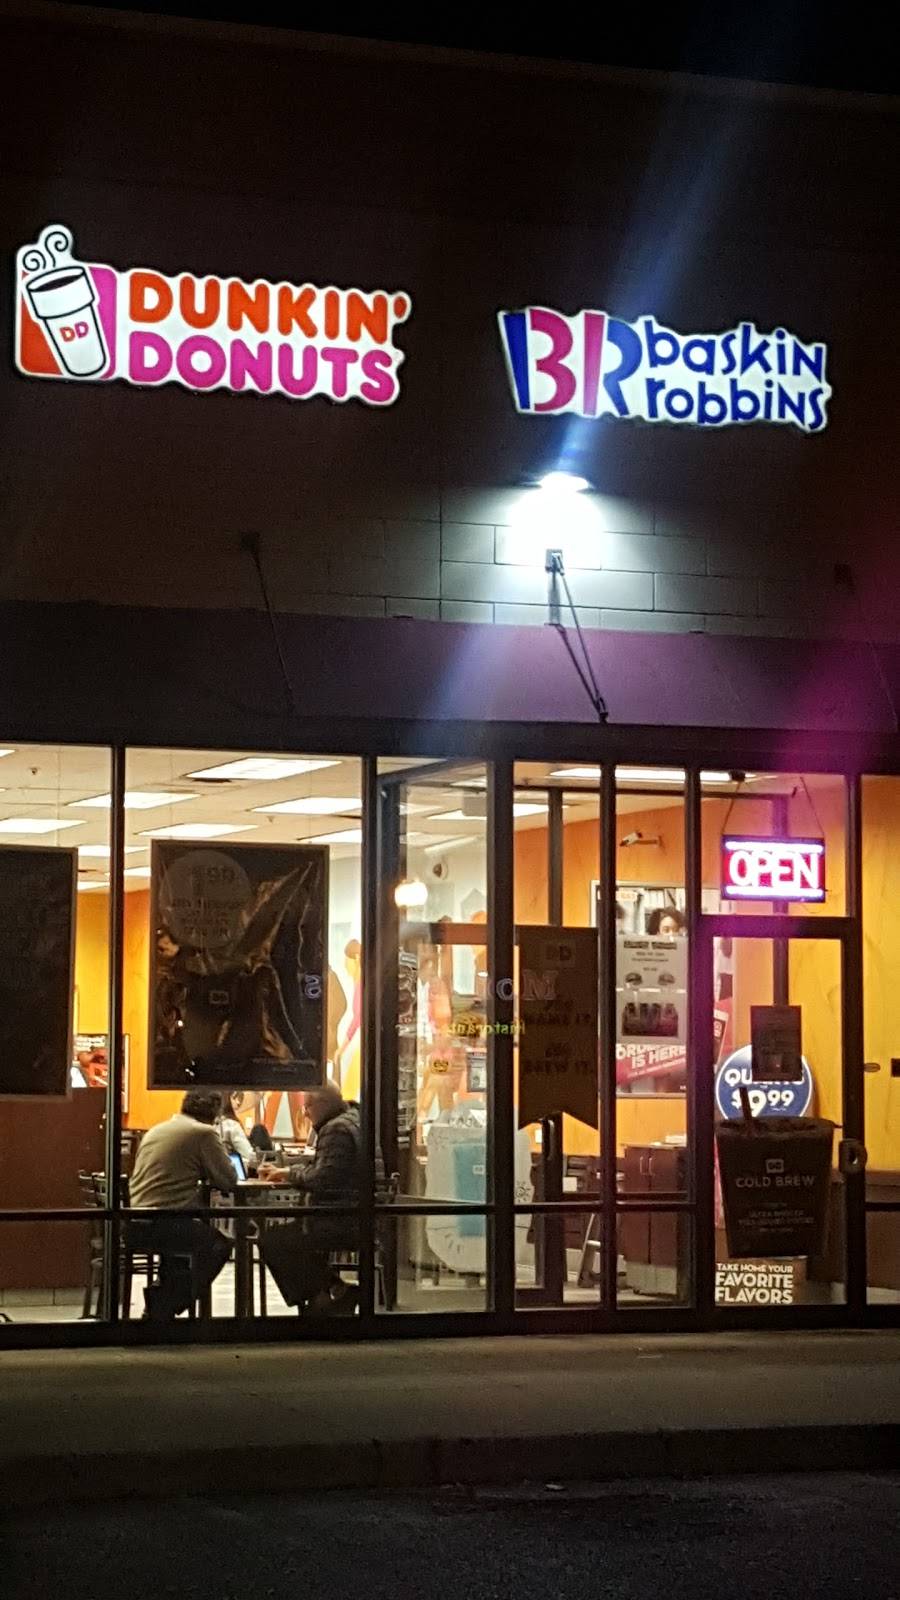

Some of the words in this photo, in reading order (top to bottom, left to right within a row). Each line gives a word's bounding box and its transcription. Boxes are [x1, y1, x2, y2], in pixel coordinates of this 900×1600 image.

[129, 271, 408, 345] DUNKIN'
[59, 321, 89, 343] DD
[128, 330, 396, 402] DONUTS
[503, 308, 643, 417] BR
[729, 849, 819, 889] OPEN
[631, 1054, 646, 1070] IS
[649, 1044, 686, 1065] HERE
[735, 1176, 772, 1188] COLD
[775, 1175, 815, 1187] BREW
[715, 1271, 794, 1289] FAVORITE
[716, 1263, 739, 1271] TAKE
[741, 1264, 766, 1273] HOME
[768, 1265, 794, 1273] YOUR
[715, 1287, 793, 1305] FLAVORS
